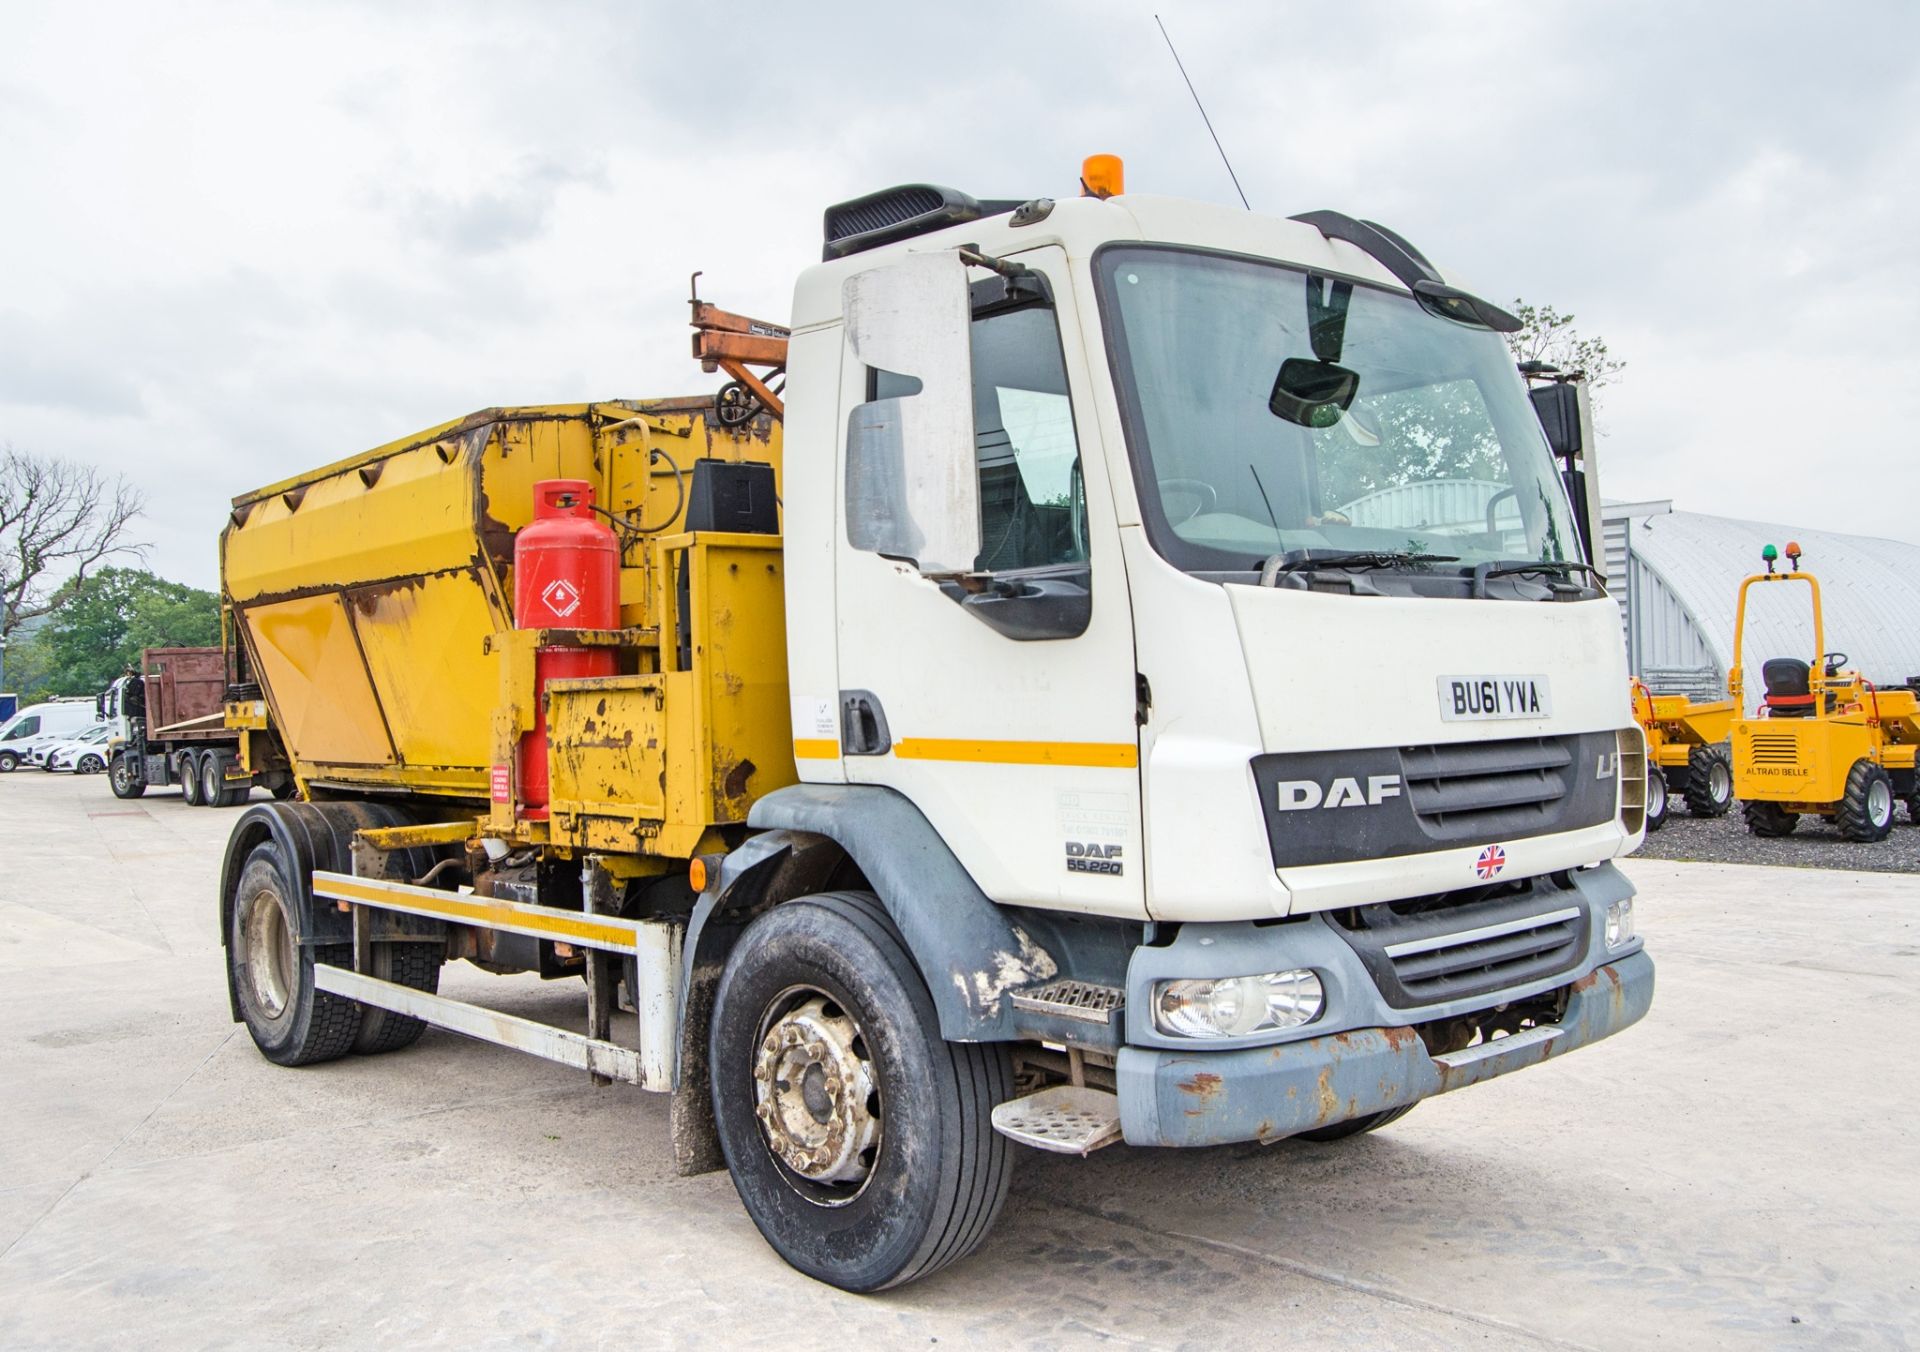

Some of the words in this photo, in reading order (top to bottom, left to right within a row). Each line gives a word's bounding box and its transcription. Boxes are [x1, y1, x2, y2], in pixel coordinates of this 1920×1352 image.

[1451, 681, 1500, 714] BU61
[1504, 681, 1540, 713] YVA
[1746, 767, 1780, 776] ALTRAD
[1782, 768, 1808, 776] BELLE
[1278, 775, 1401, 812] DAF
[1065, 841, 1122, 859] DAF
[1067, 858, 1122, 875] 55.220
